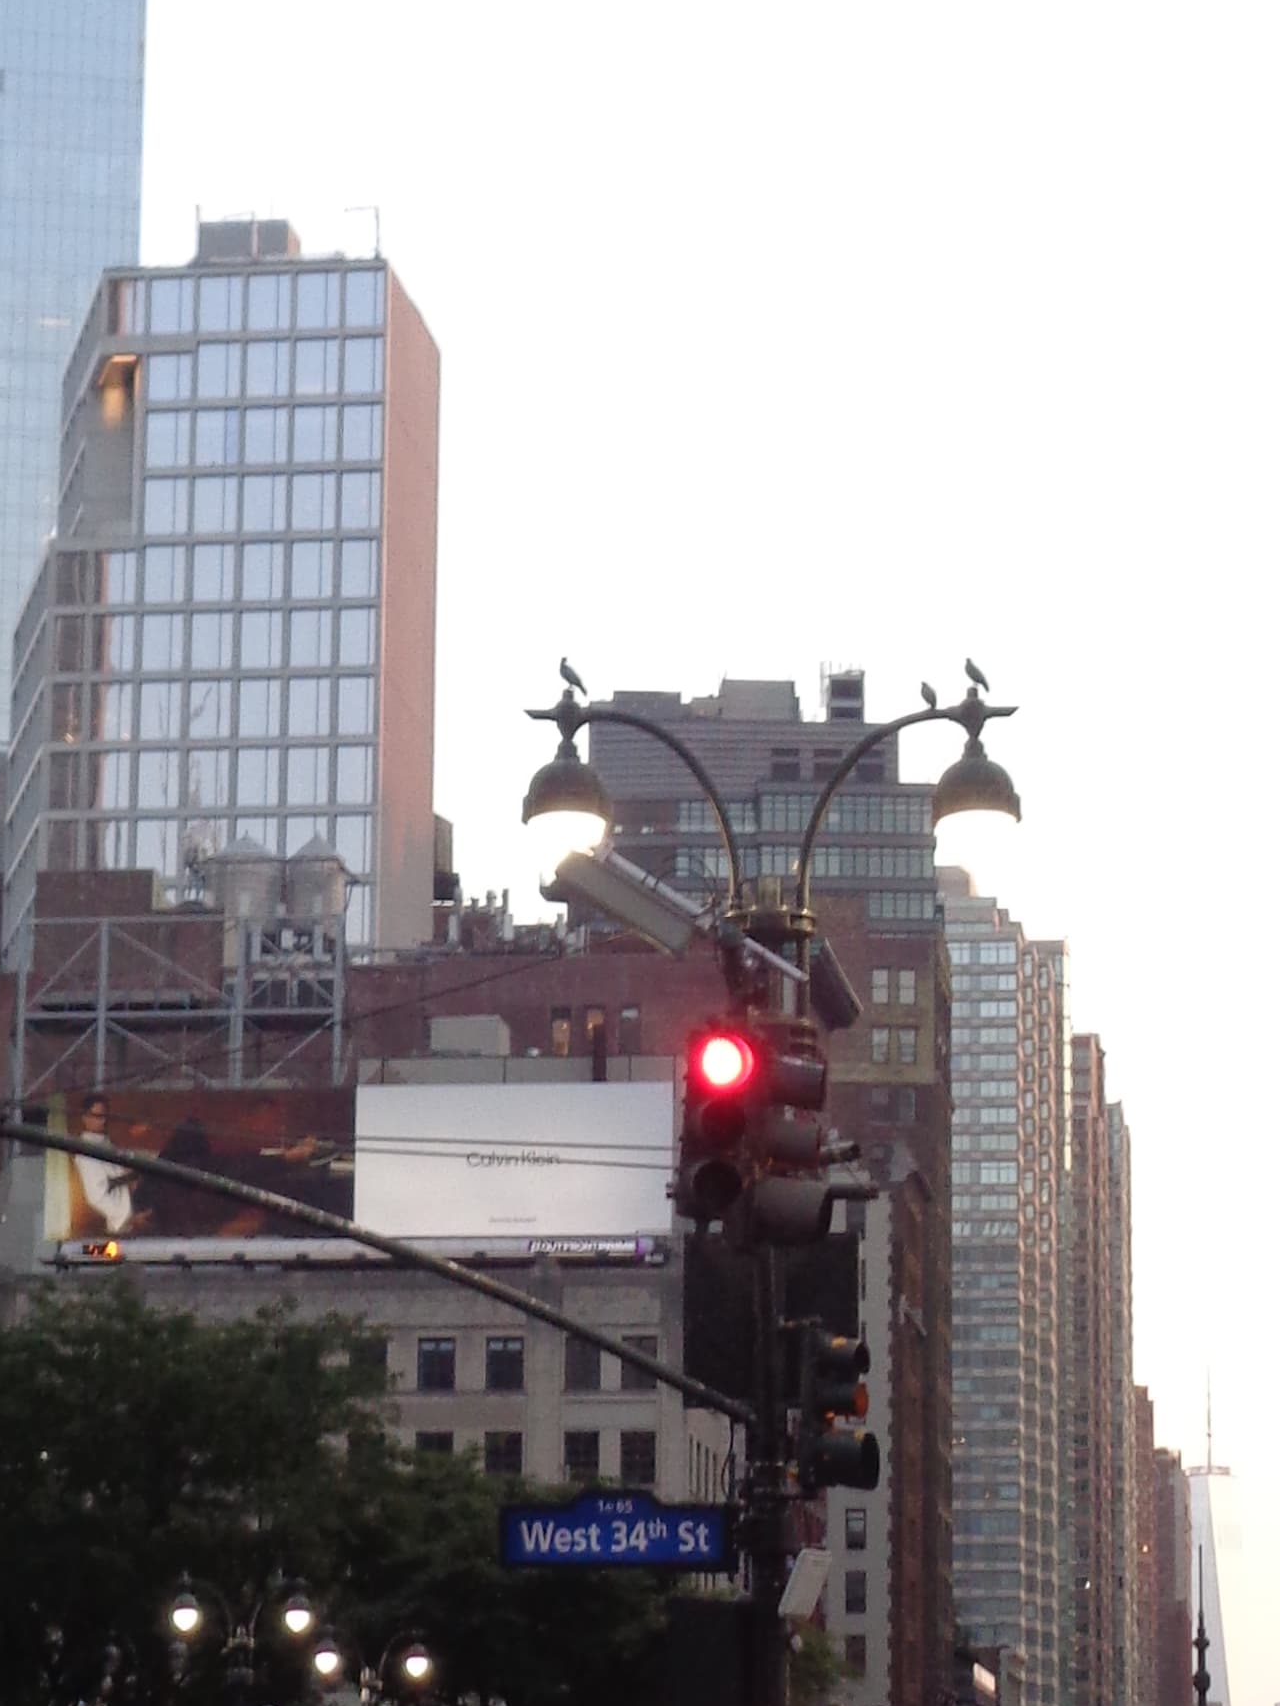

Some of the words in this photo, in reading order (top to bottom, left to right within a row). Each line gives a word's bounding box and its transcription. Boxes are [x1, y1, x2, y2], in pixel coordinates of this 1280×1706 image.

[466, 1149, 519, 1167] Calvin
[520, 1520, 601, 1553] West
[611, 1516, 668, 1553] 34th
[677, 1520, 709, 1553] St
